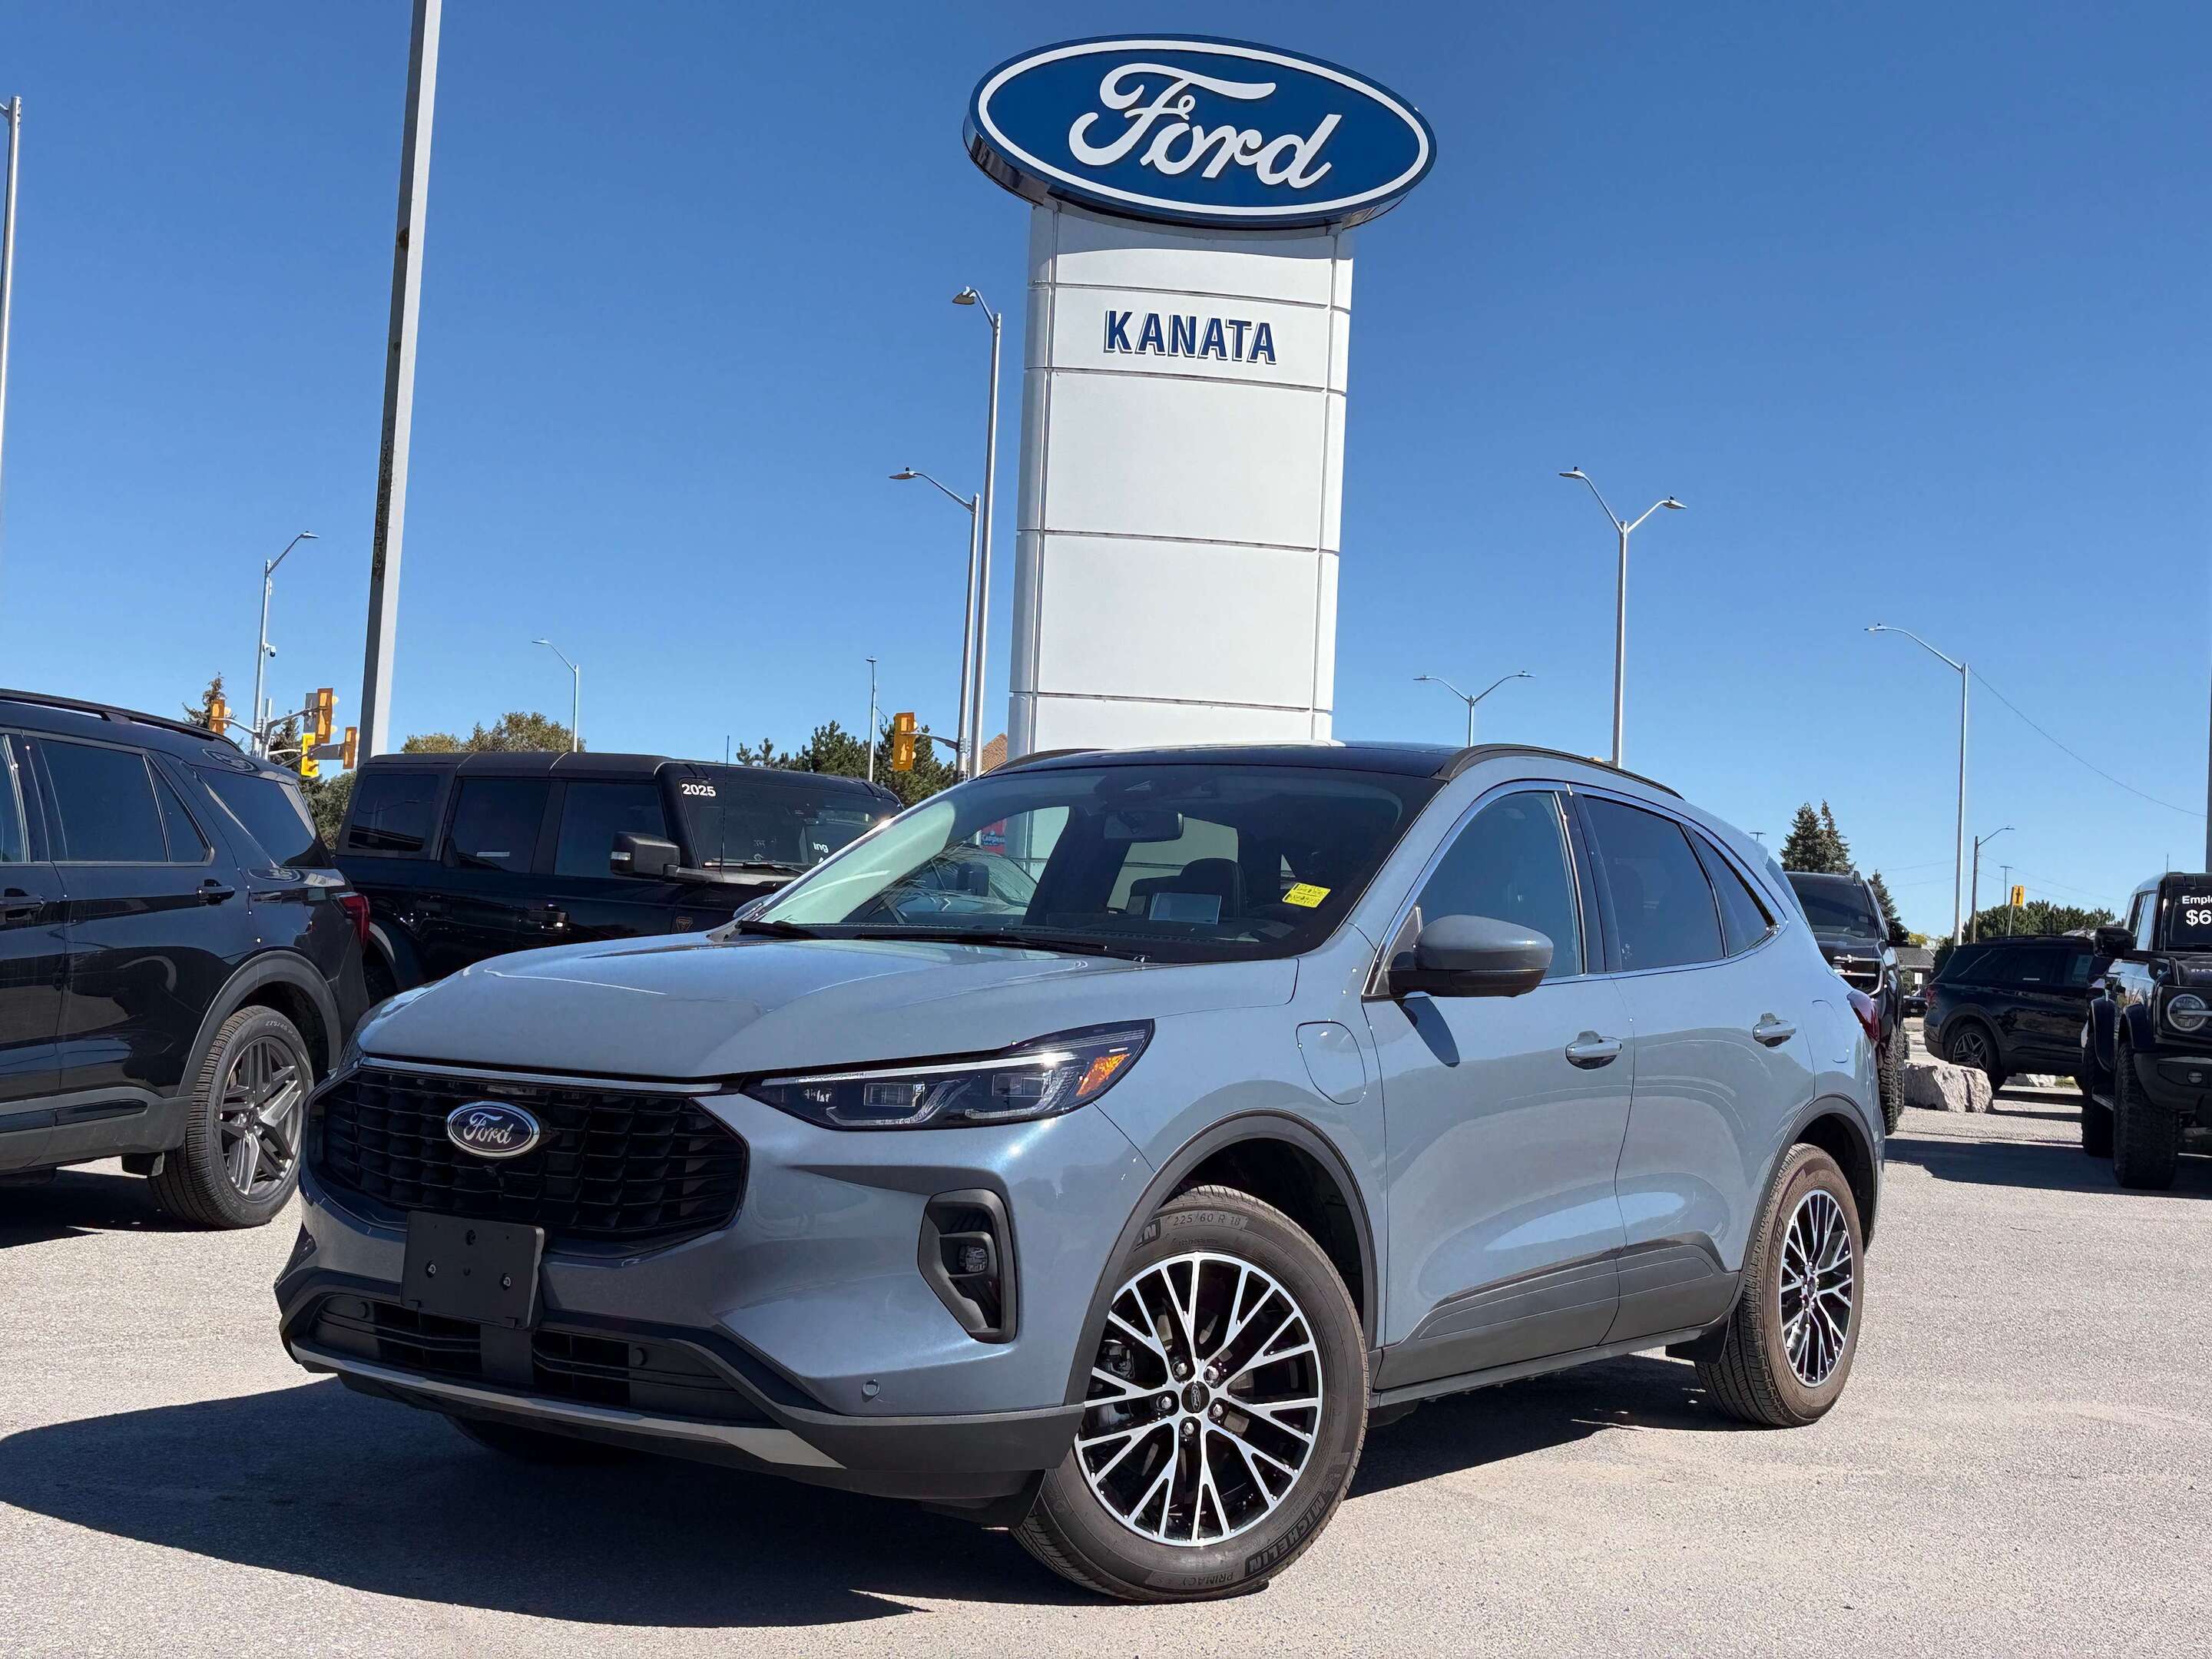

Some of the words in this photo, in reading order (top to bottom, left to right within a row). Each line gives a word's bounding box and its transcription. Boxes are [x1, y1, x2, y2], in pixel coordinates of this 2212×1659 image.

[1068, 62, 1343, 190] Ford
[1104, 310, 1277, 365] KANATA
[681, 783, 717, 797] 2025
[2181, 895, 2212, 906] Empl
[2185, 909, 2212, 927] $6
[463, 1111, 515, 1144] Ford
[1173, 1213, 1214, 1227] 225/60
[1217, 1214, 1227, 1224] R
[1230, 1216, 1241, 1227] 18
[1248, 1497, 1328, 1571] MICHELIN
